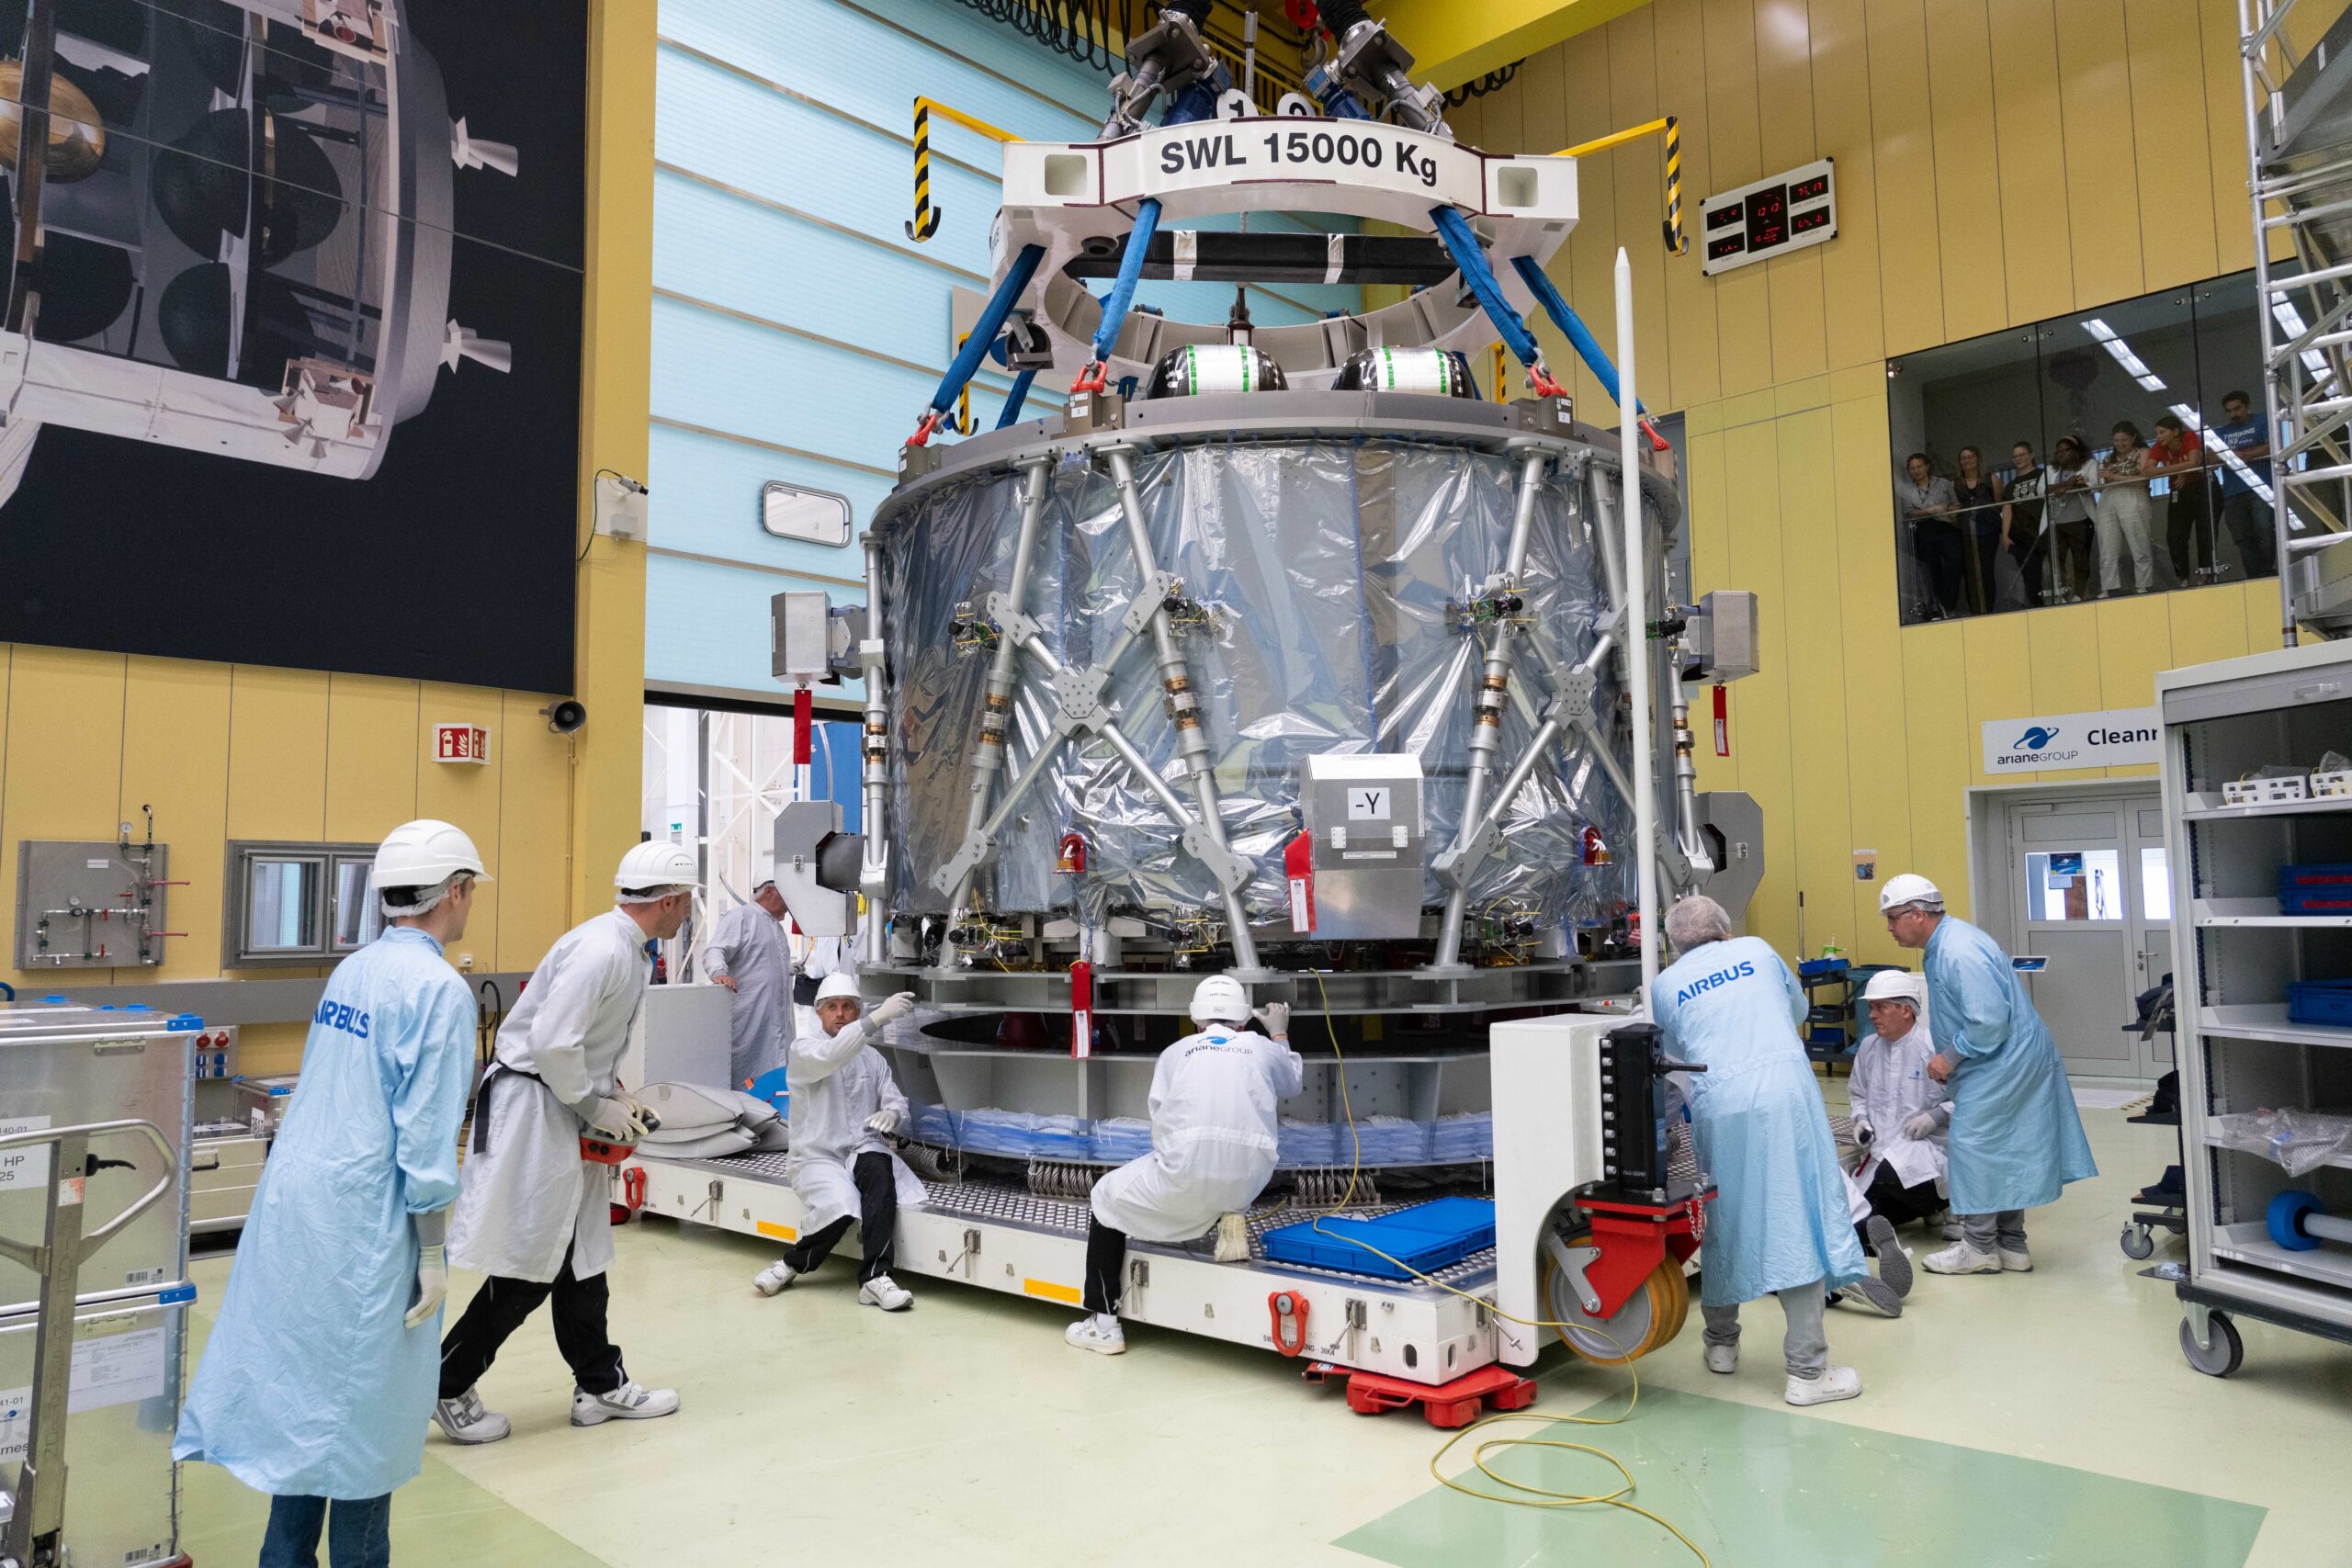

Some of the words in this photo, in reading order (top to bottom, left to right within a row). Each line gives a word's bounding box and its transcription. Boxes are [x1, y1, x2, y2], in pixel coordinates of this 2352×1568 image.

[1160, 134, 1247, 174] SWL
[1263, 132, 1383, 168] 15000
[1396, 141, 1437, 187] Kg
[1355, 792, 1380, 815] -Y
[1678, 961, 1755, 1008] AIRBUS
[4, 1155, 25, 1167] HP
